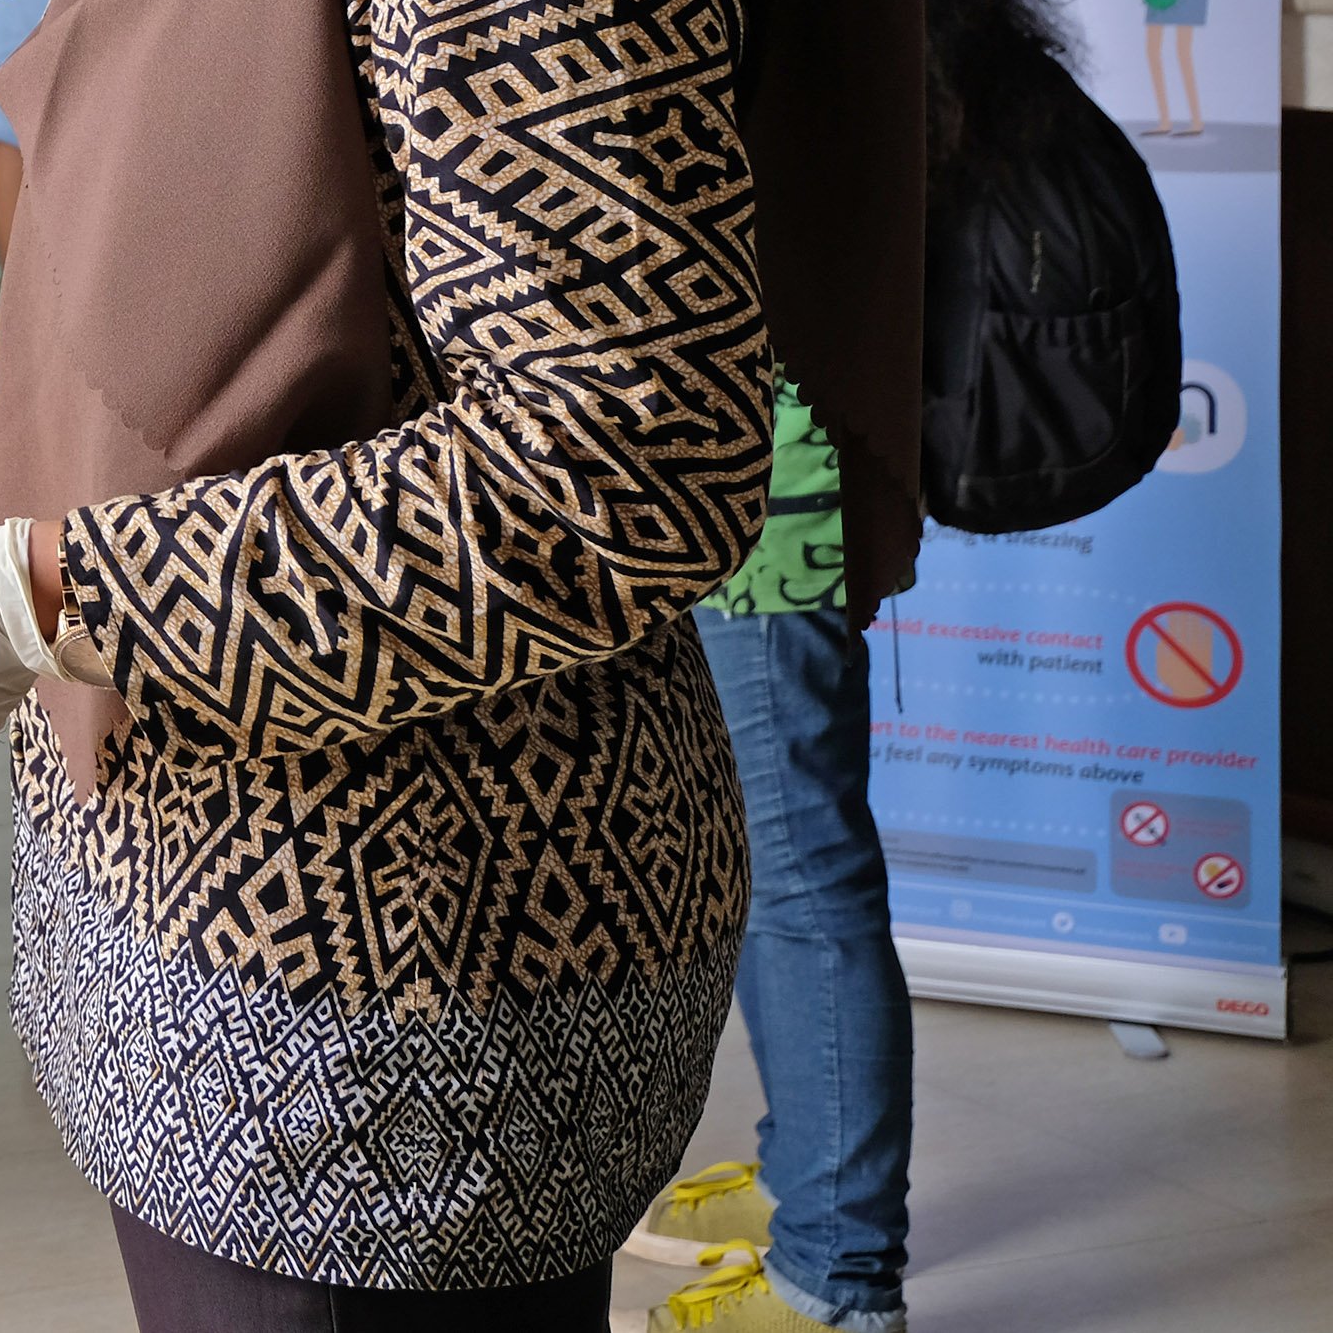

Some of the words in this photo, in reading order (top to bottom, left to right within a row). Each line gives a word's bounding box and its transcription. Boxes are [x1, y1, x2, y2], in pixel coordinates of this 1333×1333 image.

[927, 623, 1021, 643] excessive
[1025, 629, 1104, 650] contact
[977, 649, 1024, 666] with
[1029, 654, 1103, 674] patient
[885, 742, 923, 763] feel
[926, 751, 963, 769] any
[967, 754, 1073, 777] symptoms
[1079, 764, 1144, 784] above
[899, 723, 920, 738] to
[925, 724, 958, 742] the
[963, 731, 1038, 749] nearest
[1045, 734, 1110, 756] health
[1116, 744, 1161, 761] care
[1166, 748, 1258, 769] provider
